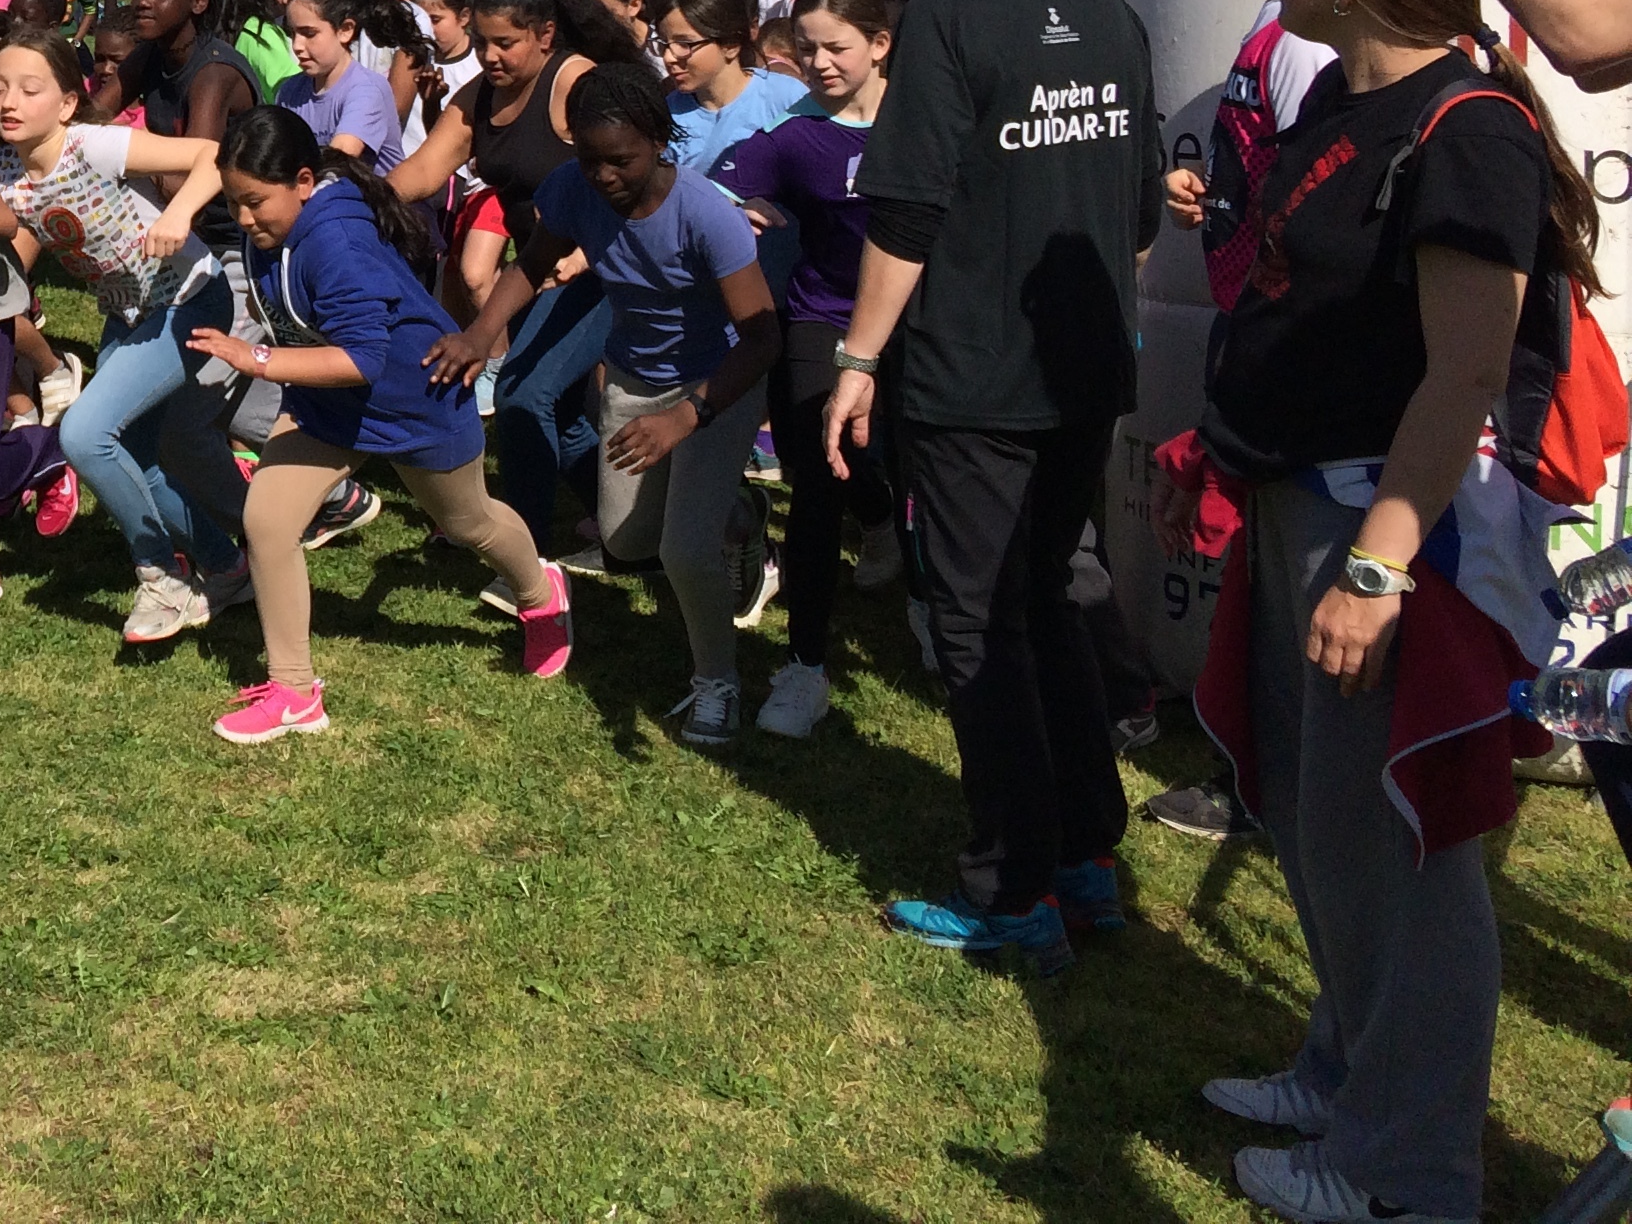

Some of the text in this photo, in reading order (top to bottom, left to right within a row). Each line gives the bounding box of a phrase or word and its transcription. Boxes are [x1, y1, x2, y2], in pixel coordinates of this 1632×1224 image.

[1030, 80, 1117, 118] Aprèn a
[999, 109, 1130, 150] CUIDAR-TE
